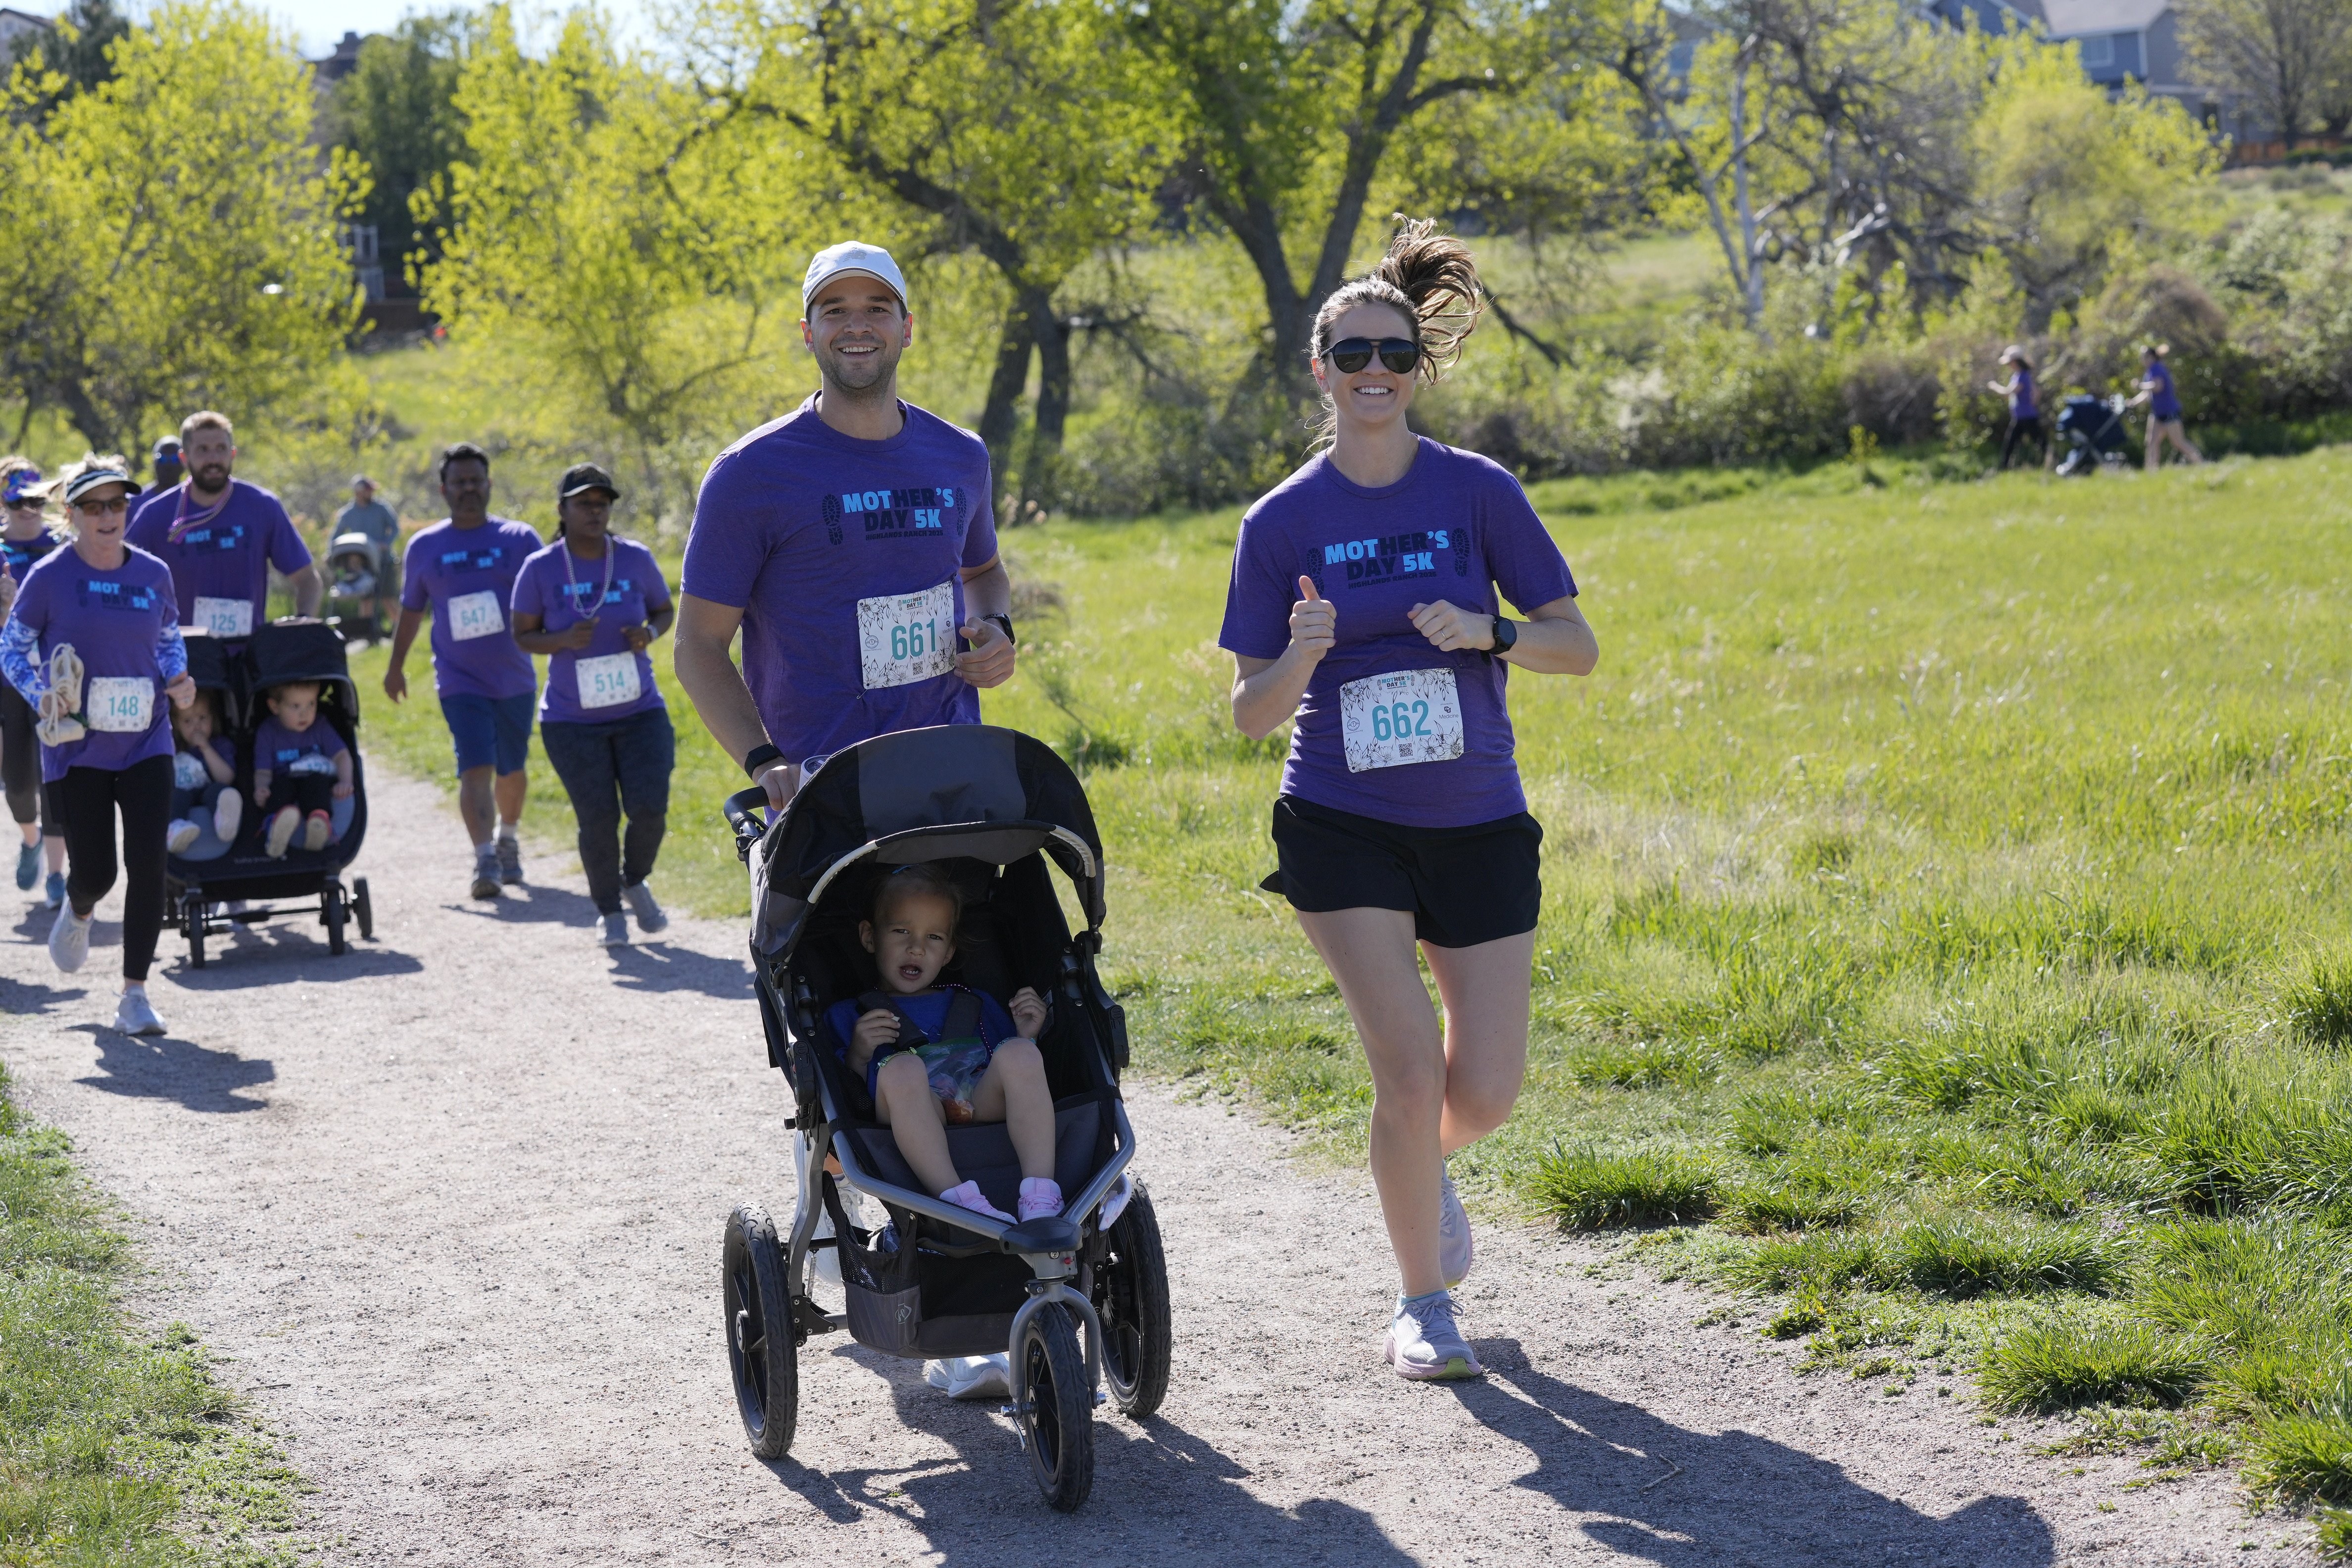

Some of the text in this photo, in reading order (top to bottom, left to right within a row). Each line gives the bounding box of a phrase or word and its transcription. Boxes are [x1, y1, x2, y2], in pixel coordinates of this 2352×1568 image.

[842, 488, 954, 513] MOTHER'S
[864, 509, 942, 532] DAY 5K
[866, 531, 902, 540] HIGHLANDS
[1324, 530, 1449, 565] MOTHER'S
[1346, 552, 1435, 581] DAY 5K
[1348, 577, 1391, 589] HIGHLANDS
[1392, 573, 1418, 581] RANCH
[902, 595, 926, 604] MOTHER'S
[211, 614, 237, 632] 125
[891, 618, 935, 660] 661
[595, 670, 625, 693] 514
[1381, 675, 1410, 684] MOTHER'S
[108, 696, 138, 716] 148
[1372, 700, 1432, 741] 662
